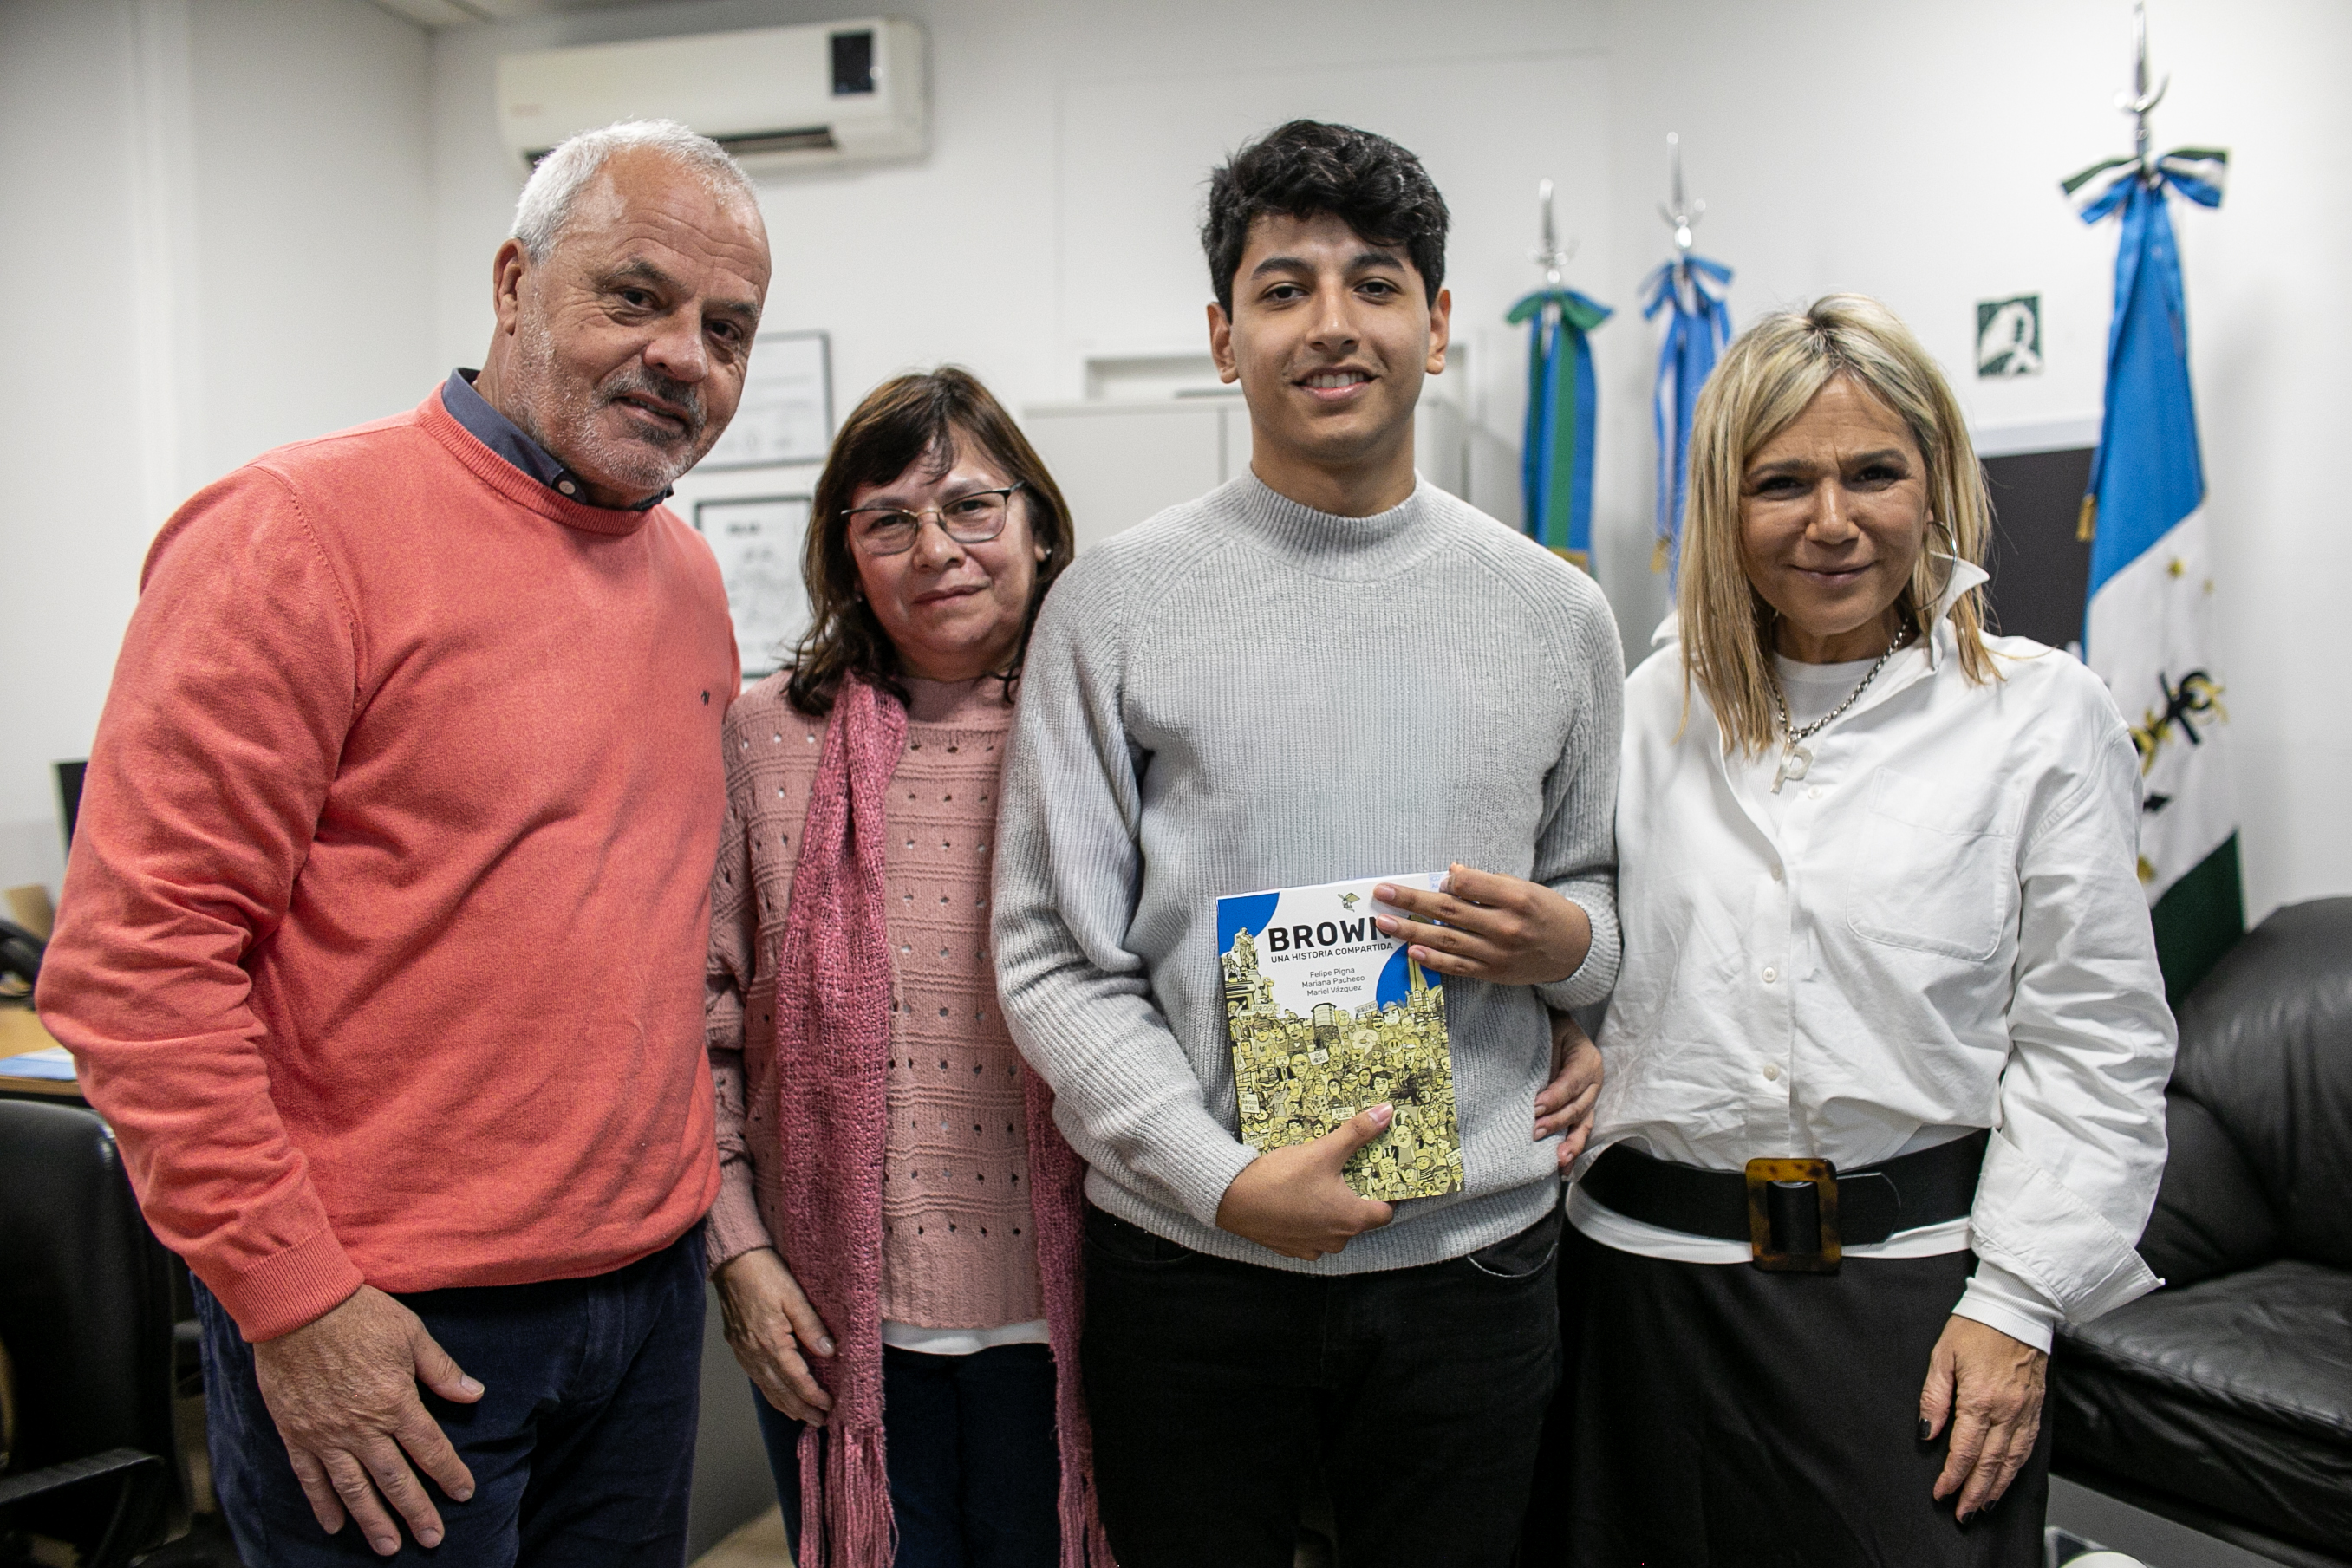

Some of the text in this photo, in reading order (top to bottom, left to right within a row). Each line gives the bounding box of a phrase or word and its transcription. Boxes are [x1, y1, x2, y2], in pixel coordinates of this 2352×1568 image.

[1271, 942, 1393, 963] UNA HISTORIA COMPARTIDA
[1310, 967, 1355, 979] Felipe Pigna
[1302, 975, 1365, 988] Mariana Pacheco
[1306, 985, 1362, 996] Mariel Vázquez
